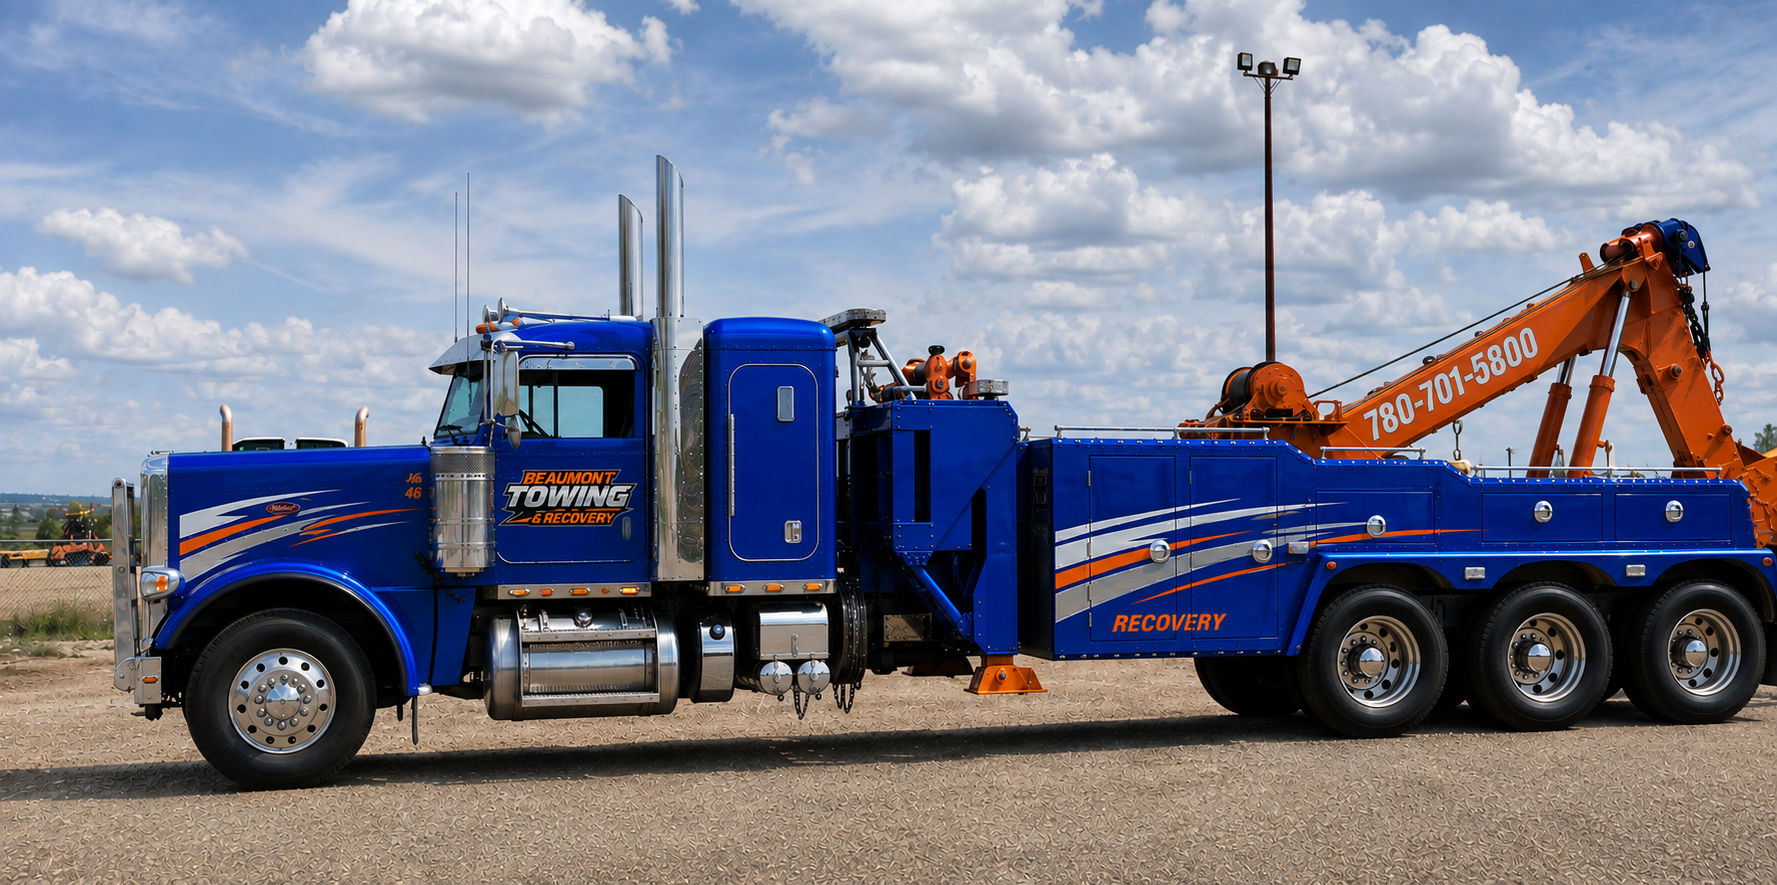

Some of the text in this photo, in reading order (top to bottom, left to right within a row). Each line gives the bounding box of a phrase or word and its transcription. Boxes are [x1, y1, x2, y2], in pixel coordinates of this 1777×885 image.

[1363, 327, 1539, 442] 780-701-5800
[523, 472, 616, 485] BEAUMONT
[405, 487, 422, 499] 46
[507, 485, 632, 508] TOWING
[531, 512, 616, 524] & RECOVERY
[1112, 613, 1227, 633] RECOVERY
